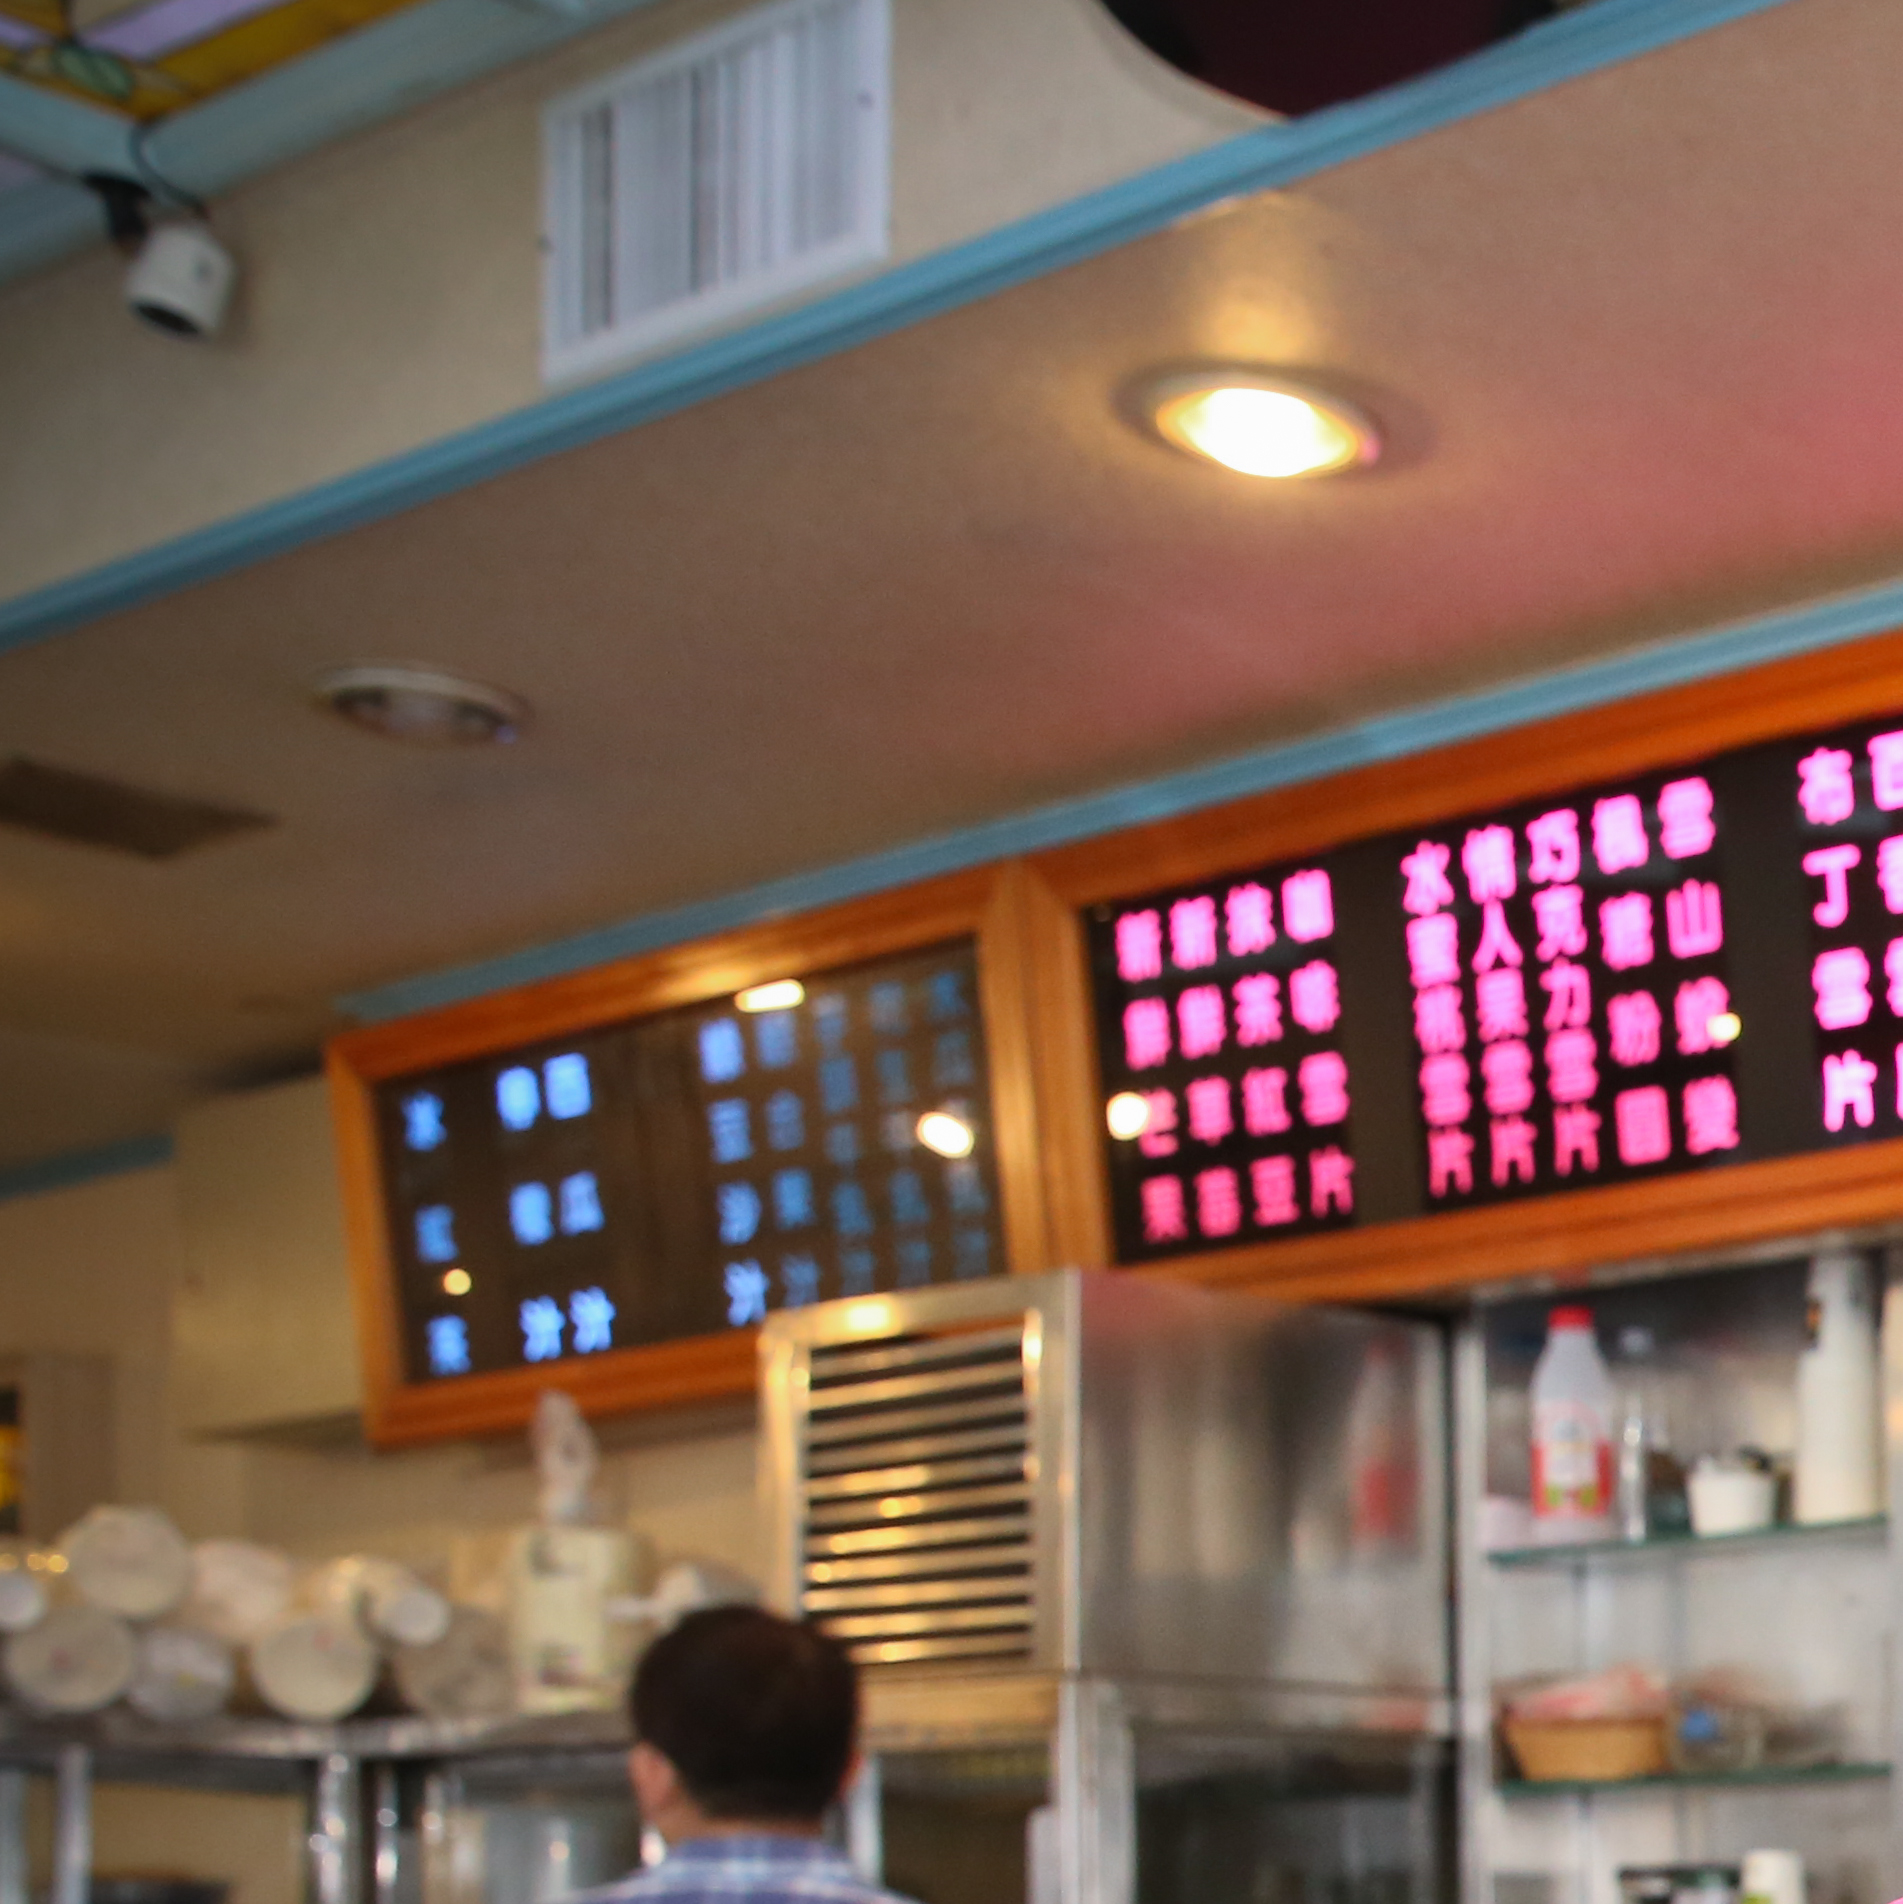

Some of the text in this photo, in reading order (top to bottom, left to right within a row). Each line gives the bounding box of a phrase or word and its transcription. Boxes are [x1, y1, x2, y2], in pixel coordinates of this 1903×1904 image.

[1526, 809, 1600, 1176] 巧克力雪片
[1798, 748, 1877, 1132] 布丁雪片
